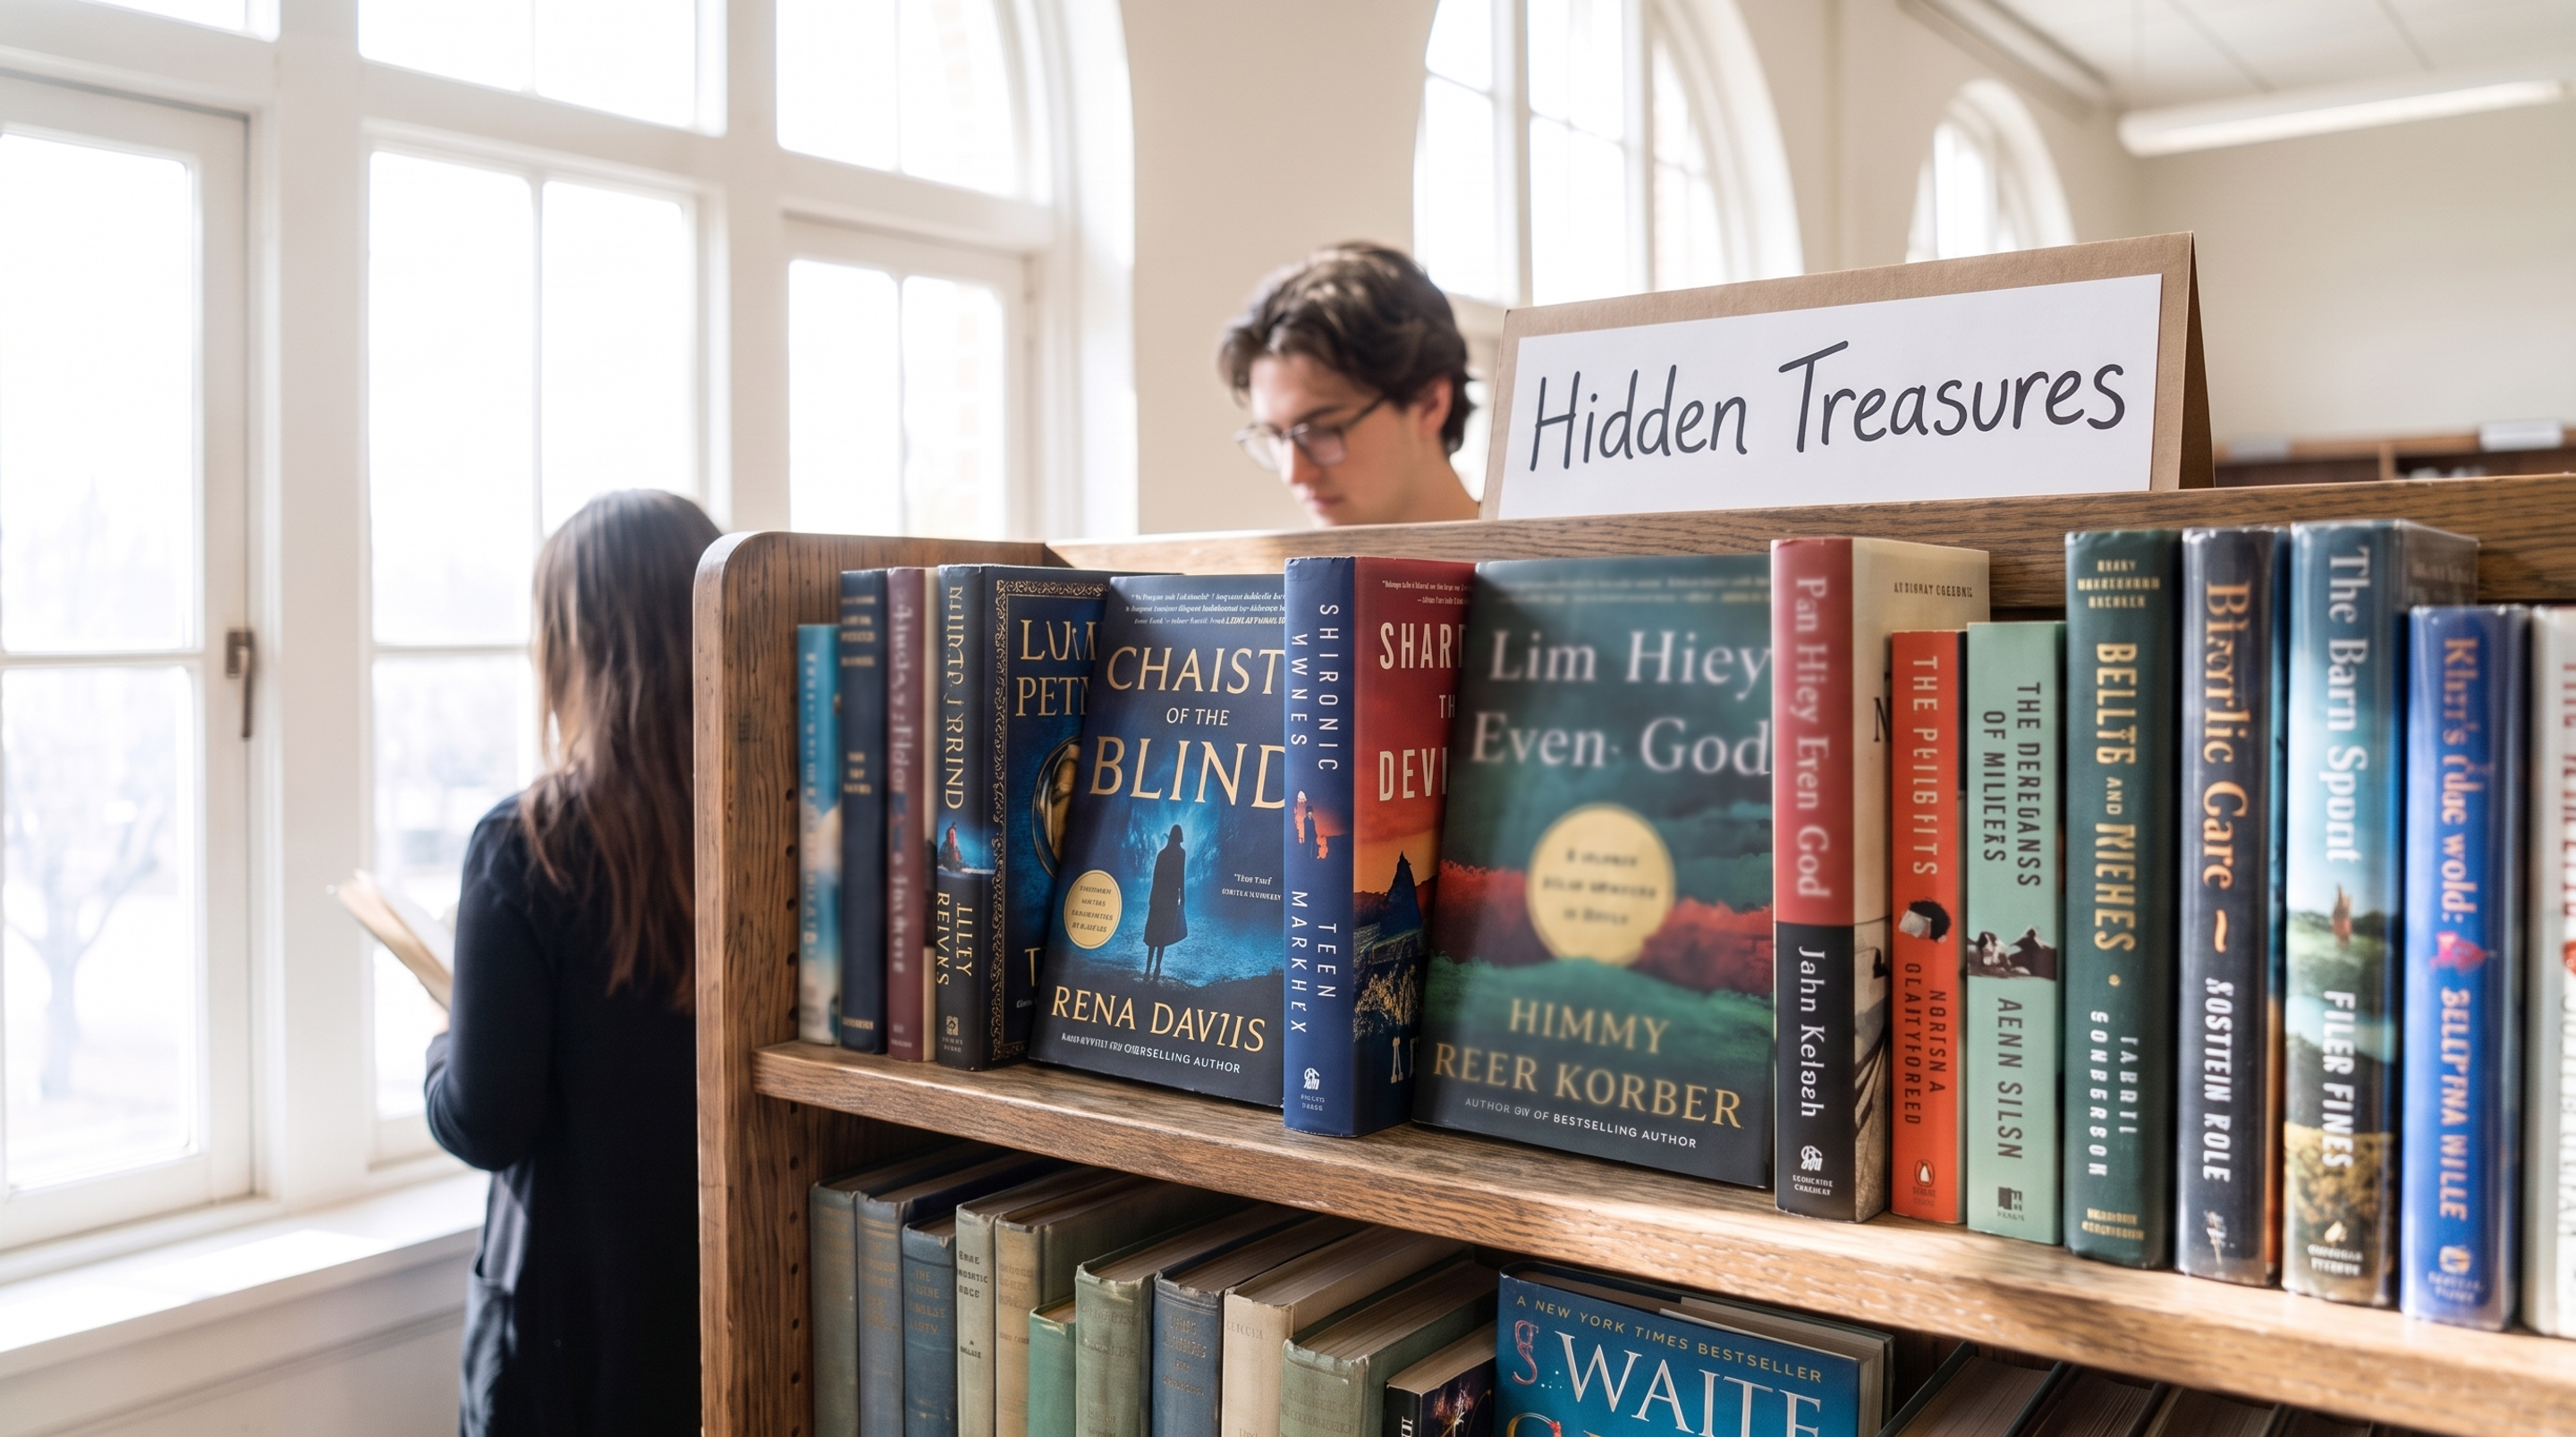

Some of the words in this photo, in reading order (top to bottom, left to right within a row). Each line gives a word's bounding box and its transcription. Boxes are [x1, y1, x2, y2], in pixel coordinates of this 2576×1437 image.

[1530, 364, 1748, 472] Hidden
[1778, 340, 2126, 454] Treasures
[2328, 545, 2370, 624] The
[1318, 604, 1339, 770] SHIRONIC
[1488, 630, 1597, 682] Lim
[1625, 630, 1771, 702] Hiey
[1913, 655, 1938, 712] THE
[2327, 638, 2369, 731] Barn
[1166, 707, 1190, 724] OF
[1195, 709, 1230, 726] THE
[1438, 694, 1456, 718] TH
[1983, 710, 2006, 740] OF
[2017, 681, 2041, 729] THE
[1089, 736, 1284, 809] BLIND
[1640, 717, 1771, 776] God
[2106, 775, 2123, 816] AND
[1796, 825, 1831, 898] God
[2202, 780, 2249, 890] Care
[1318, 923, 1336, 997] TEEN
[1799, 945, 1826, 1013] Jahn
[1051, 985, 1136, 1030] RENA
[1508, 998, 1671, 1054] HIMMY
[1997, 997, 2022, 1069] AENN
[2323, 989, 2356, 1076] FILER
[1194, 1056, 1241, 1073] AUTHOR
[1434, 1043, 1538, 1093] REER
[1464, 1097, 1511, 1113] AUTHOR
[1534, 1110, 1549, 1120] OF
[1554, 1113, 1638, 1138] BESTSELLING
[1641, 1129, 1697, 1149] AUTHOR
[1997, 1080, 2022, 1159] SILSN
[2203, 1112, 2232, 1184] ROLE
[2322, 1081, 2355, 1169] FINES
[1516, 1295, 1527, 1306] A
[1536, 1299, 1571, 1318] NEW
[1580, 1312, 1626, 1334] YORK
[1635, 1325, 1689, 1350] TIMES
[1699, 1342, 1823, 1383] BESTSELLER
